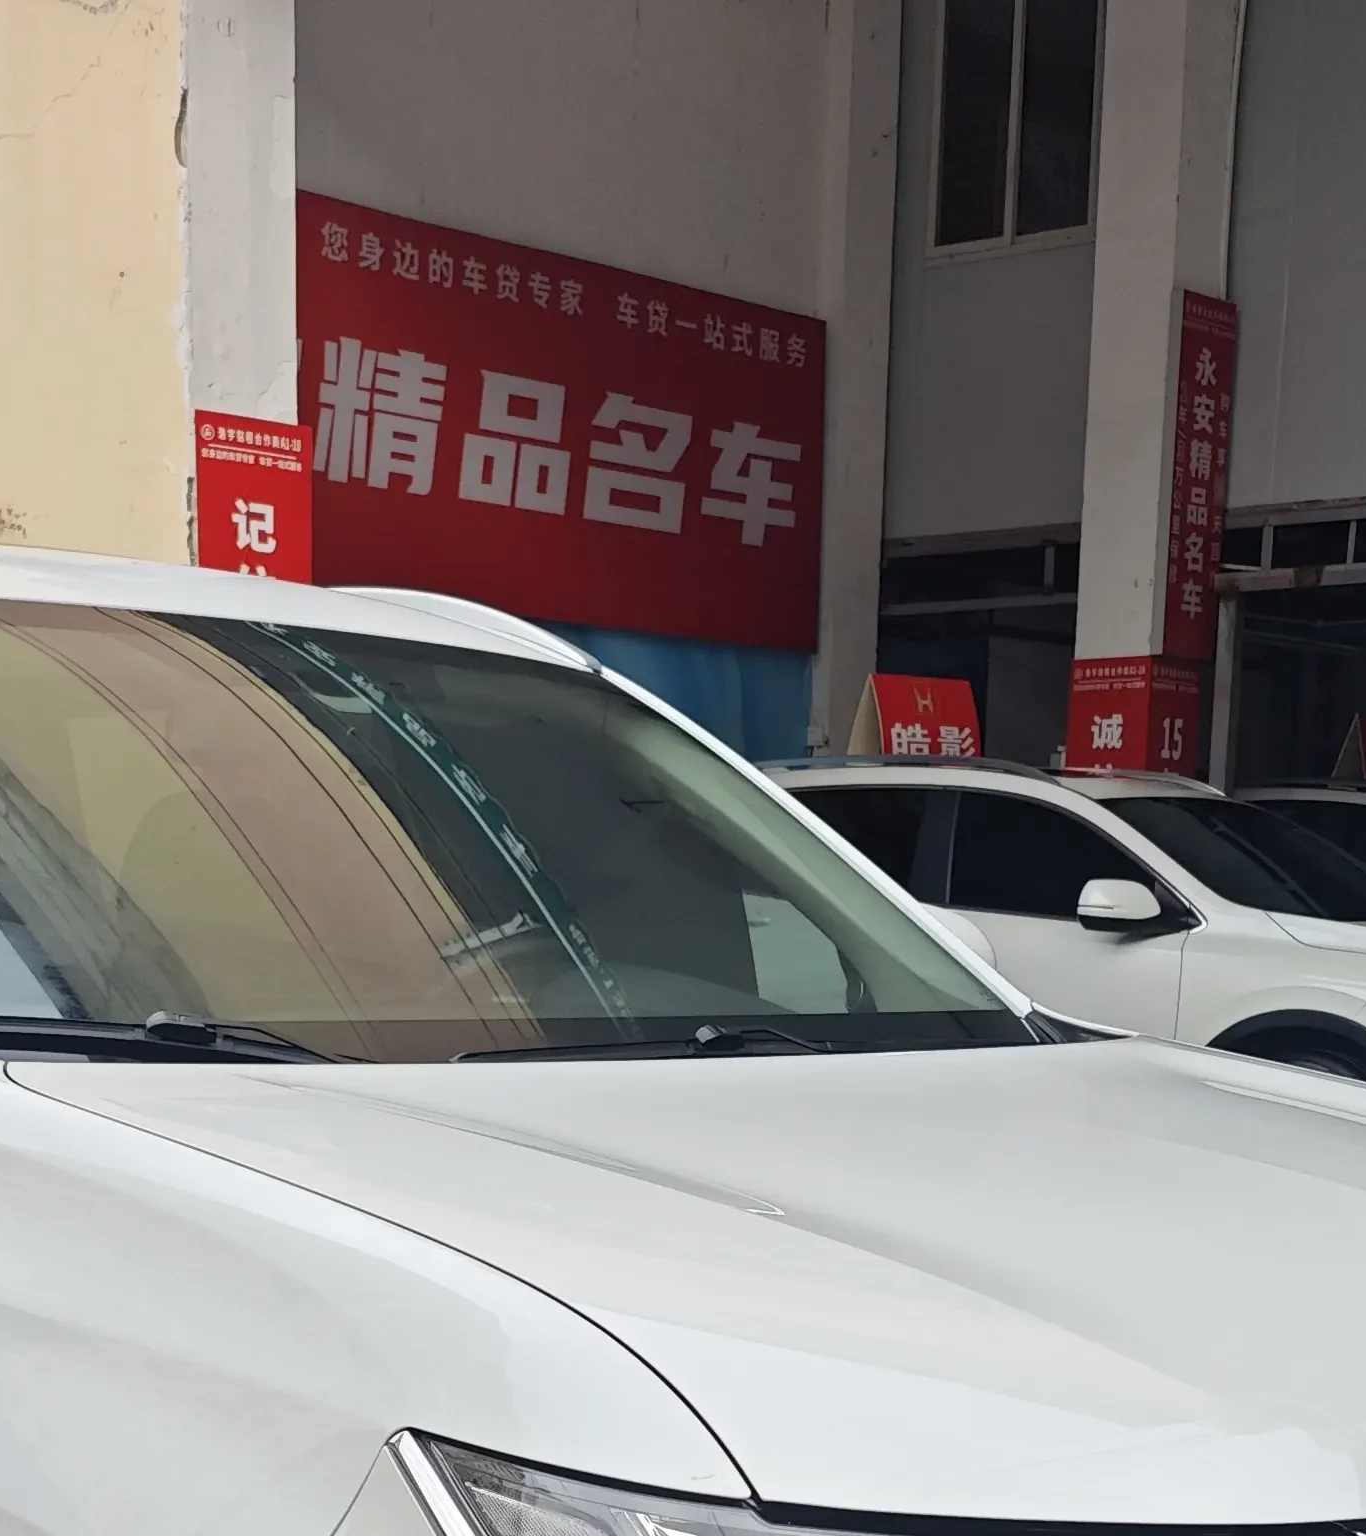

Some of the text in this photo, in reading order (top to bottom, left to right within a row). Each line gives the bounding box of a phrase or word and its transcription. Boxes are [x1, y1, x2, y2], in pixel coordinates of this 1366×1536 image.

[321, 221, 807, 369] 您身边的车贷专家 车贷一站式服务
[297, 335, 802, 547] 精品名车
[1180, 347, 1218, 619] 永安精品名车
[891, 722, 976, 757] 皓影
[1091, 713, 1123, 770] 诚
[1160, 717, 1184, 760] 15
